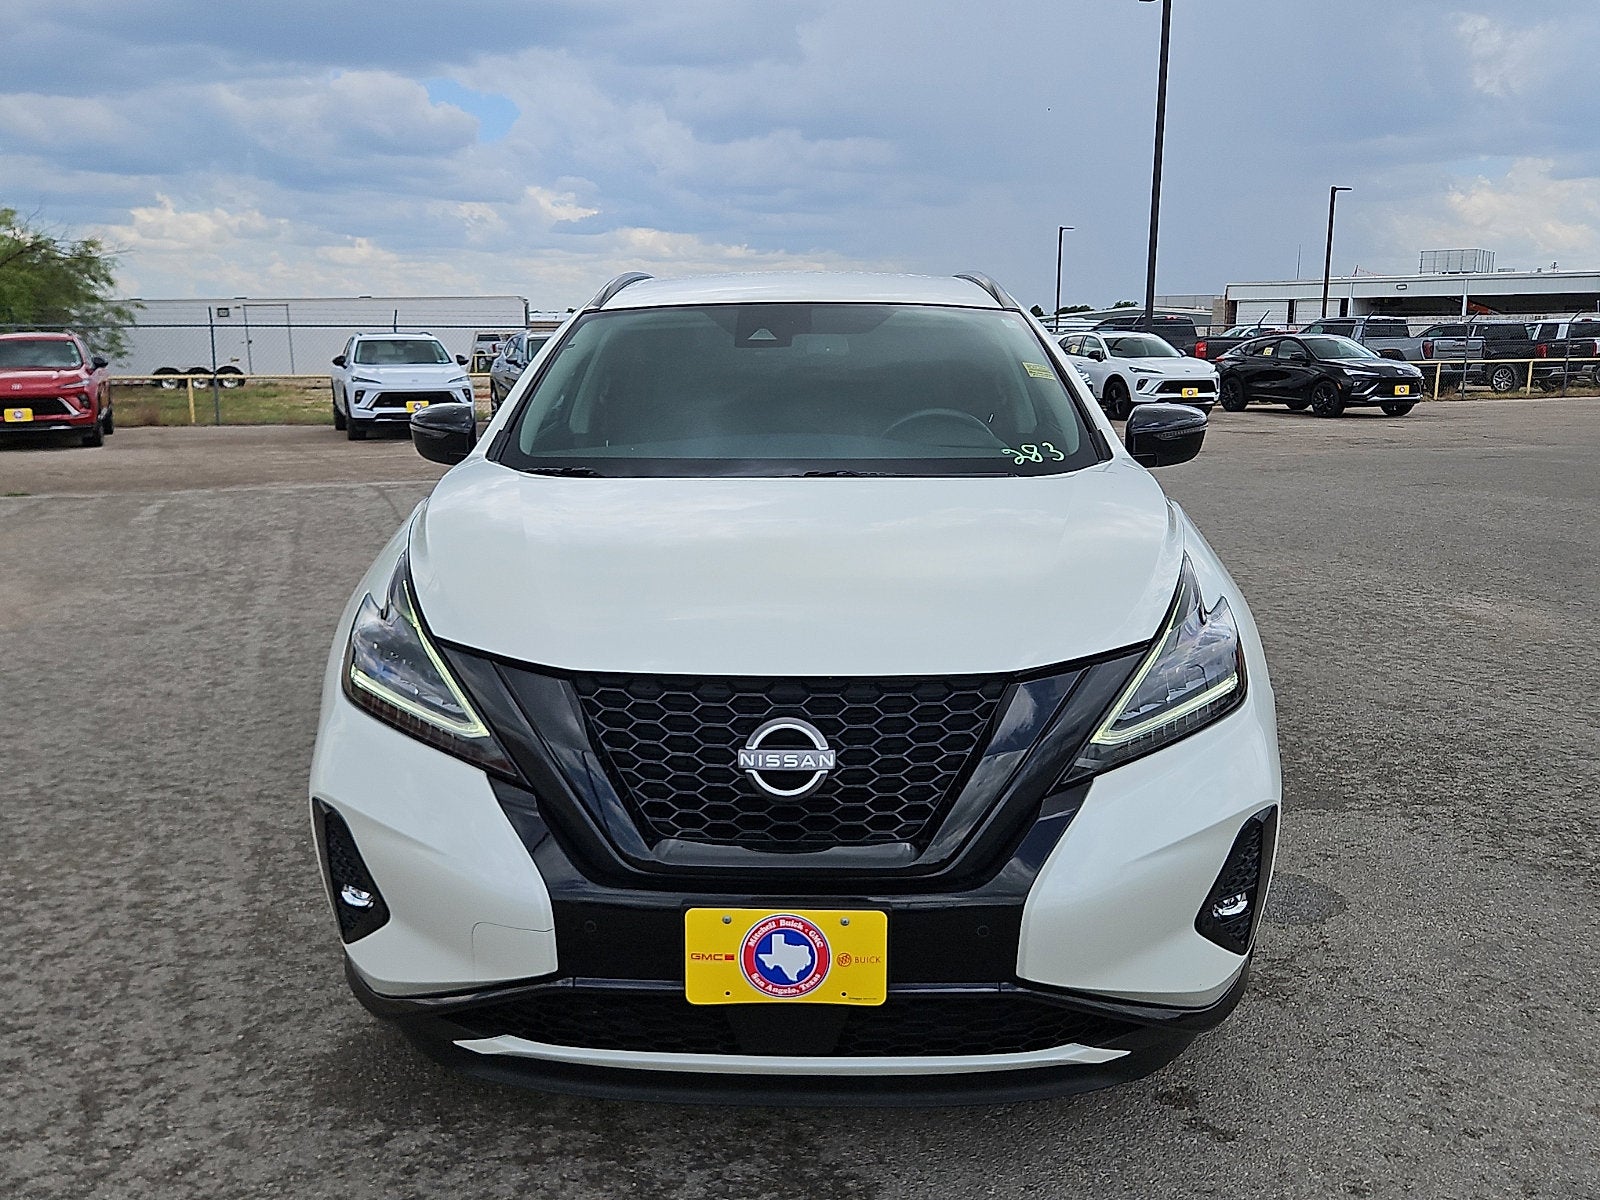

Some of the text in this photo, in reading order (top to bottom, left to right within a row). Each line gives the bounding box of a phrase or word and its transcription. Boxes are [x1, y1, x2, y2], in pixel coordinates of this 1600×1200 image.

[1001, 442, 1065, 465] 283
[740, 753, 834, 768] NISSAN
[748, 919, 824, 948] Mitchell Buick GMC
[690, 952, 723, 961] GMC
[854, 956, 881, 964] BUICK
[750, 972, 766, 988] San
[799, 973, 821, 991] Texas
